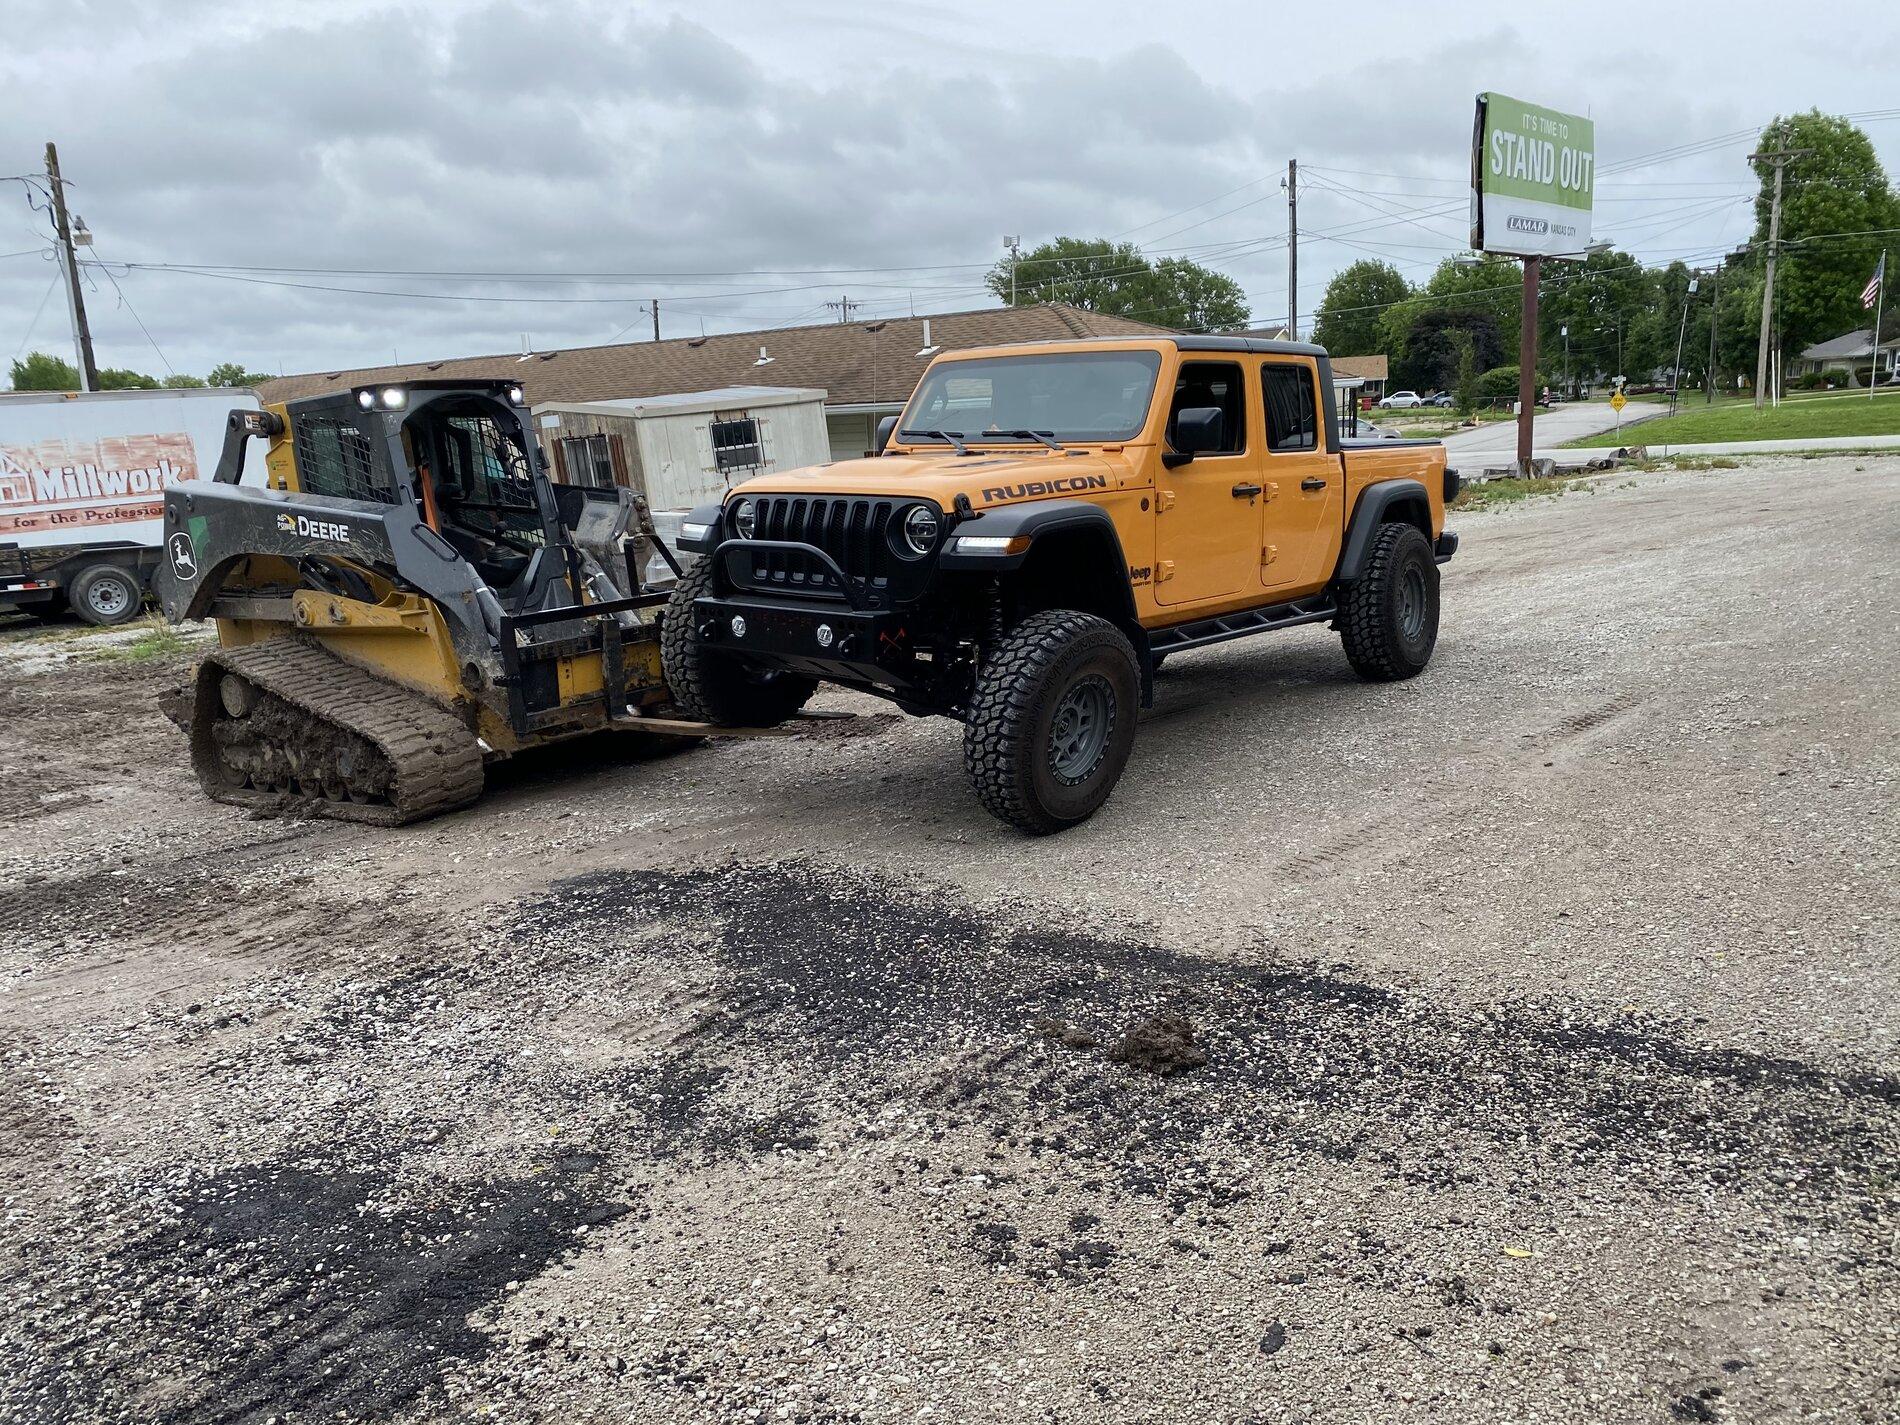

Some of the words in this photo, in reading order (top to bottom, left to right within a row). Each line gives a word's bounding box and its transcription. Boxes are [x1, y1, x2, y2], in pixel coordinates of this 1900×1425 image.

[1522, 113, 1537, 132] IT'S
[1540, 118, 1557, 136] TIME
[1558, 123, 1569, 140] TO
[1491, 129, 1555, 185] STAND
[1560, 146, 1592, 193] OUT
[1510, 218, 1544, 233] LAMAR
[1551, 223, 1567, 237] KANSAS
[1567, 225, 1577, 237] CITY
[32, 458, 183, 502] Millwork
[981, 475, 1107, 502] RUBICON
[14, 517, 38, 528] for
[51, 513, 78, 524] the
[297, 515, 350, 542] DEERE
[1129, 566, 1151, 580] Jeep
